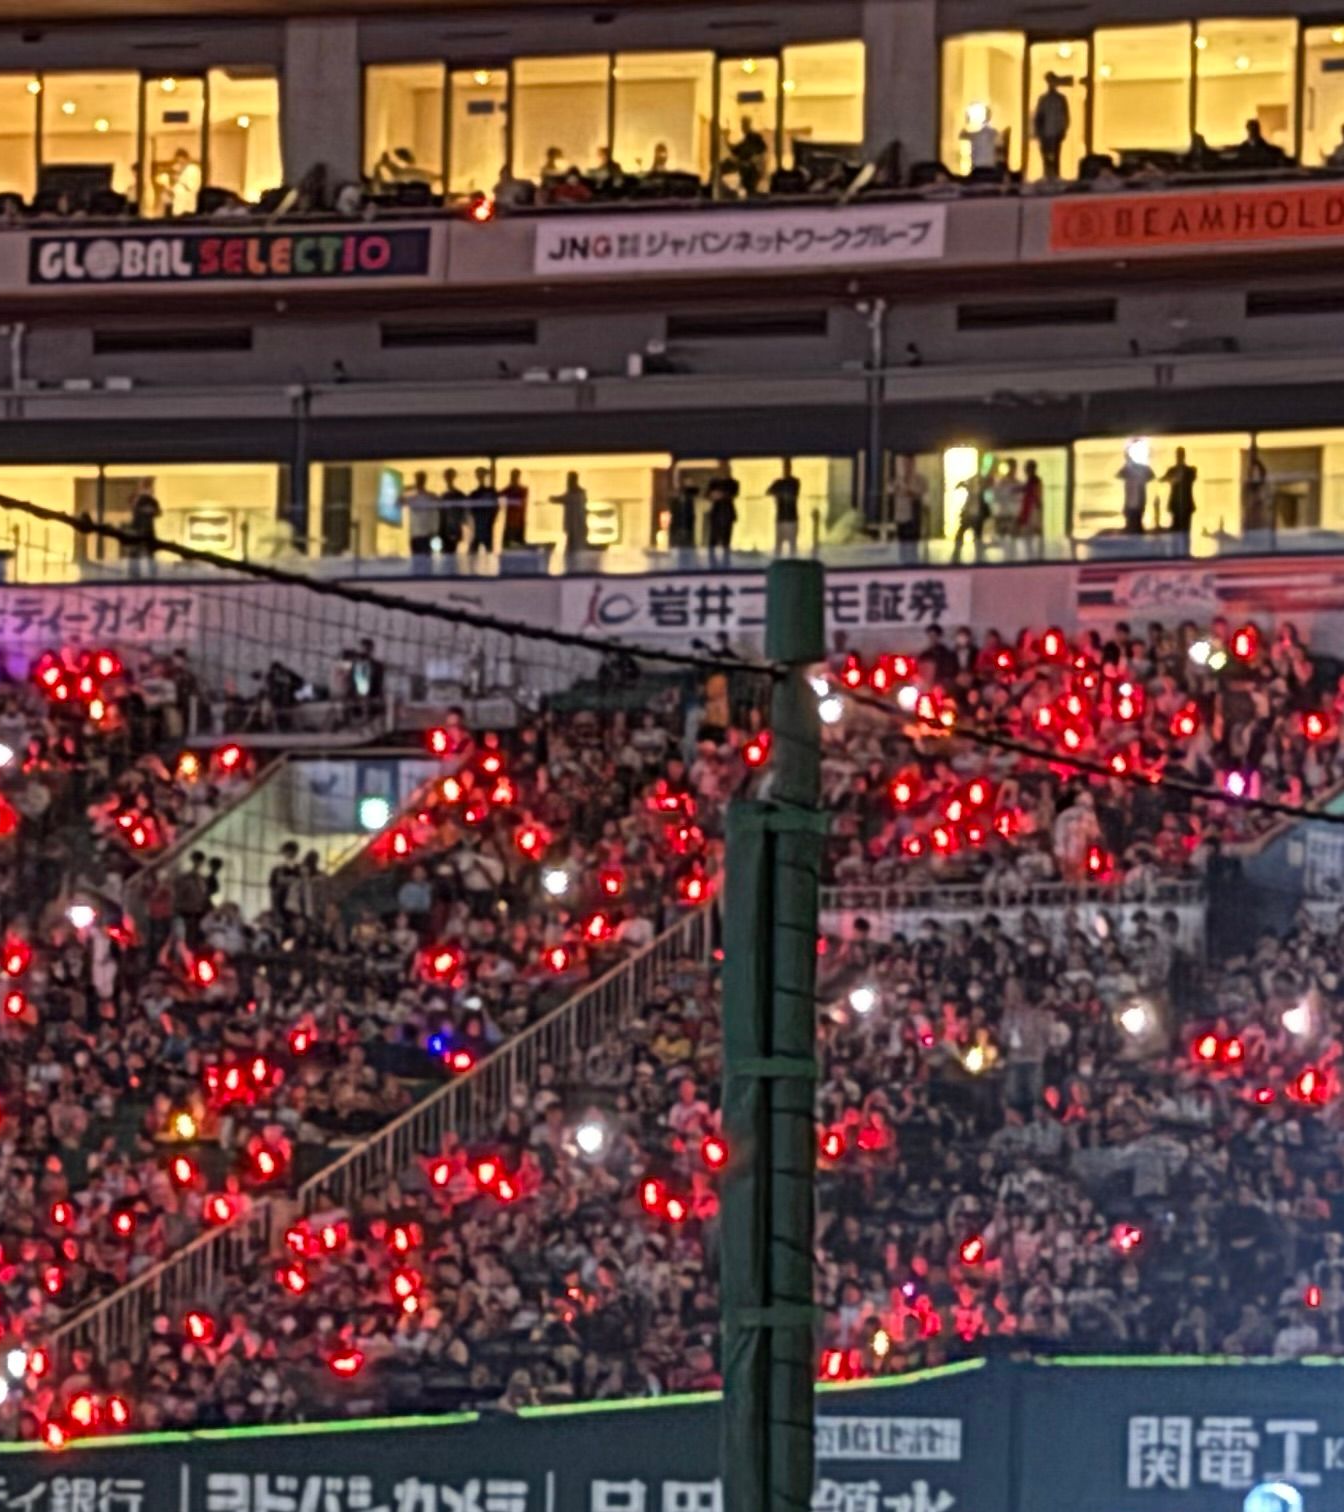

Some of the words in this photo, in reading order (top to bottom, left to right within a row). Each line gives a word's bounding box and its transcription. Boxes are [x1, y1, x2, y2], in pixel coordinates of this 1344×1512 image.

[38, 237, 193, 280] GLOBAL
[198, 235, 392, 274] SELECTIO
[649, 579, 949, 629] 岩井コモ証券
[1128, 1415, 1322, 1488] 関電工
